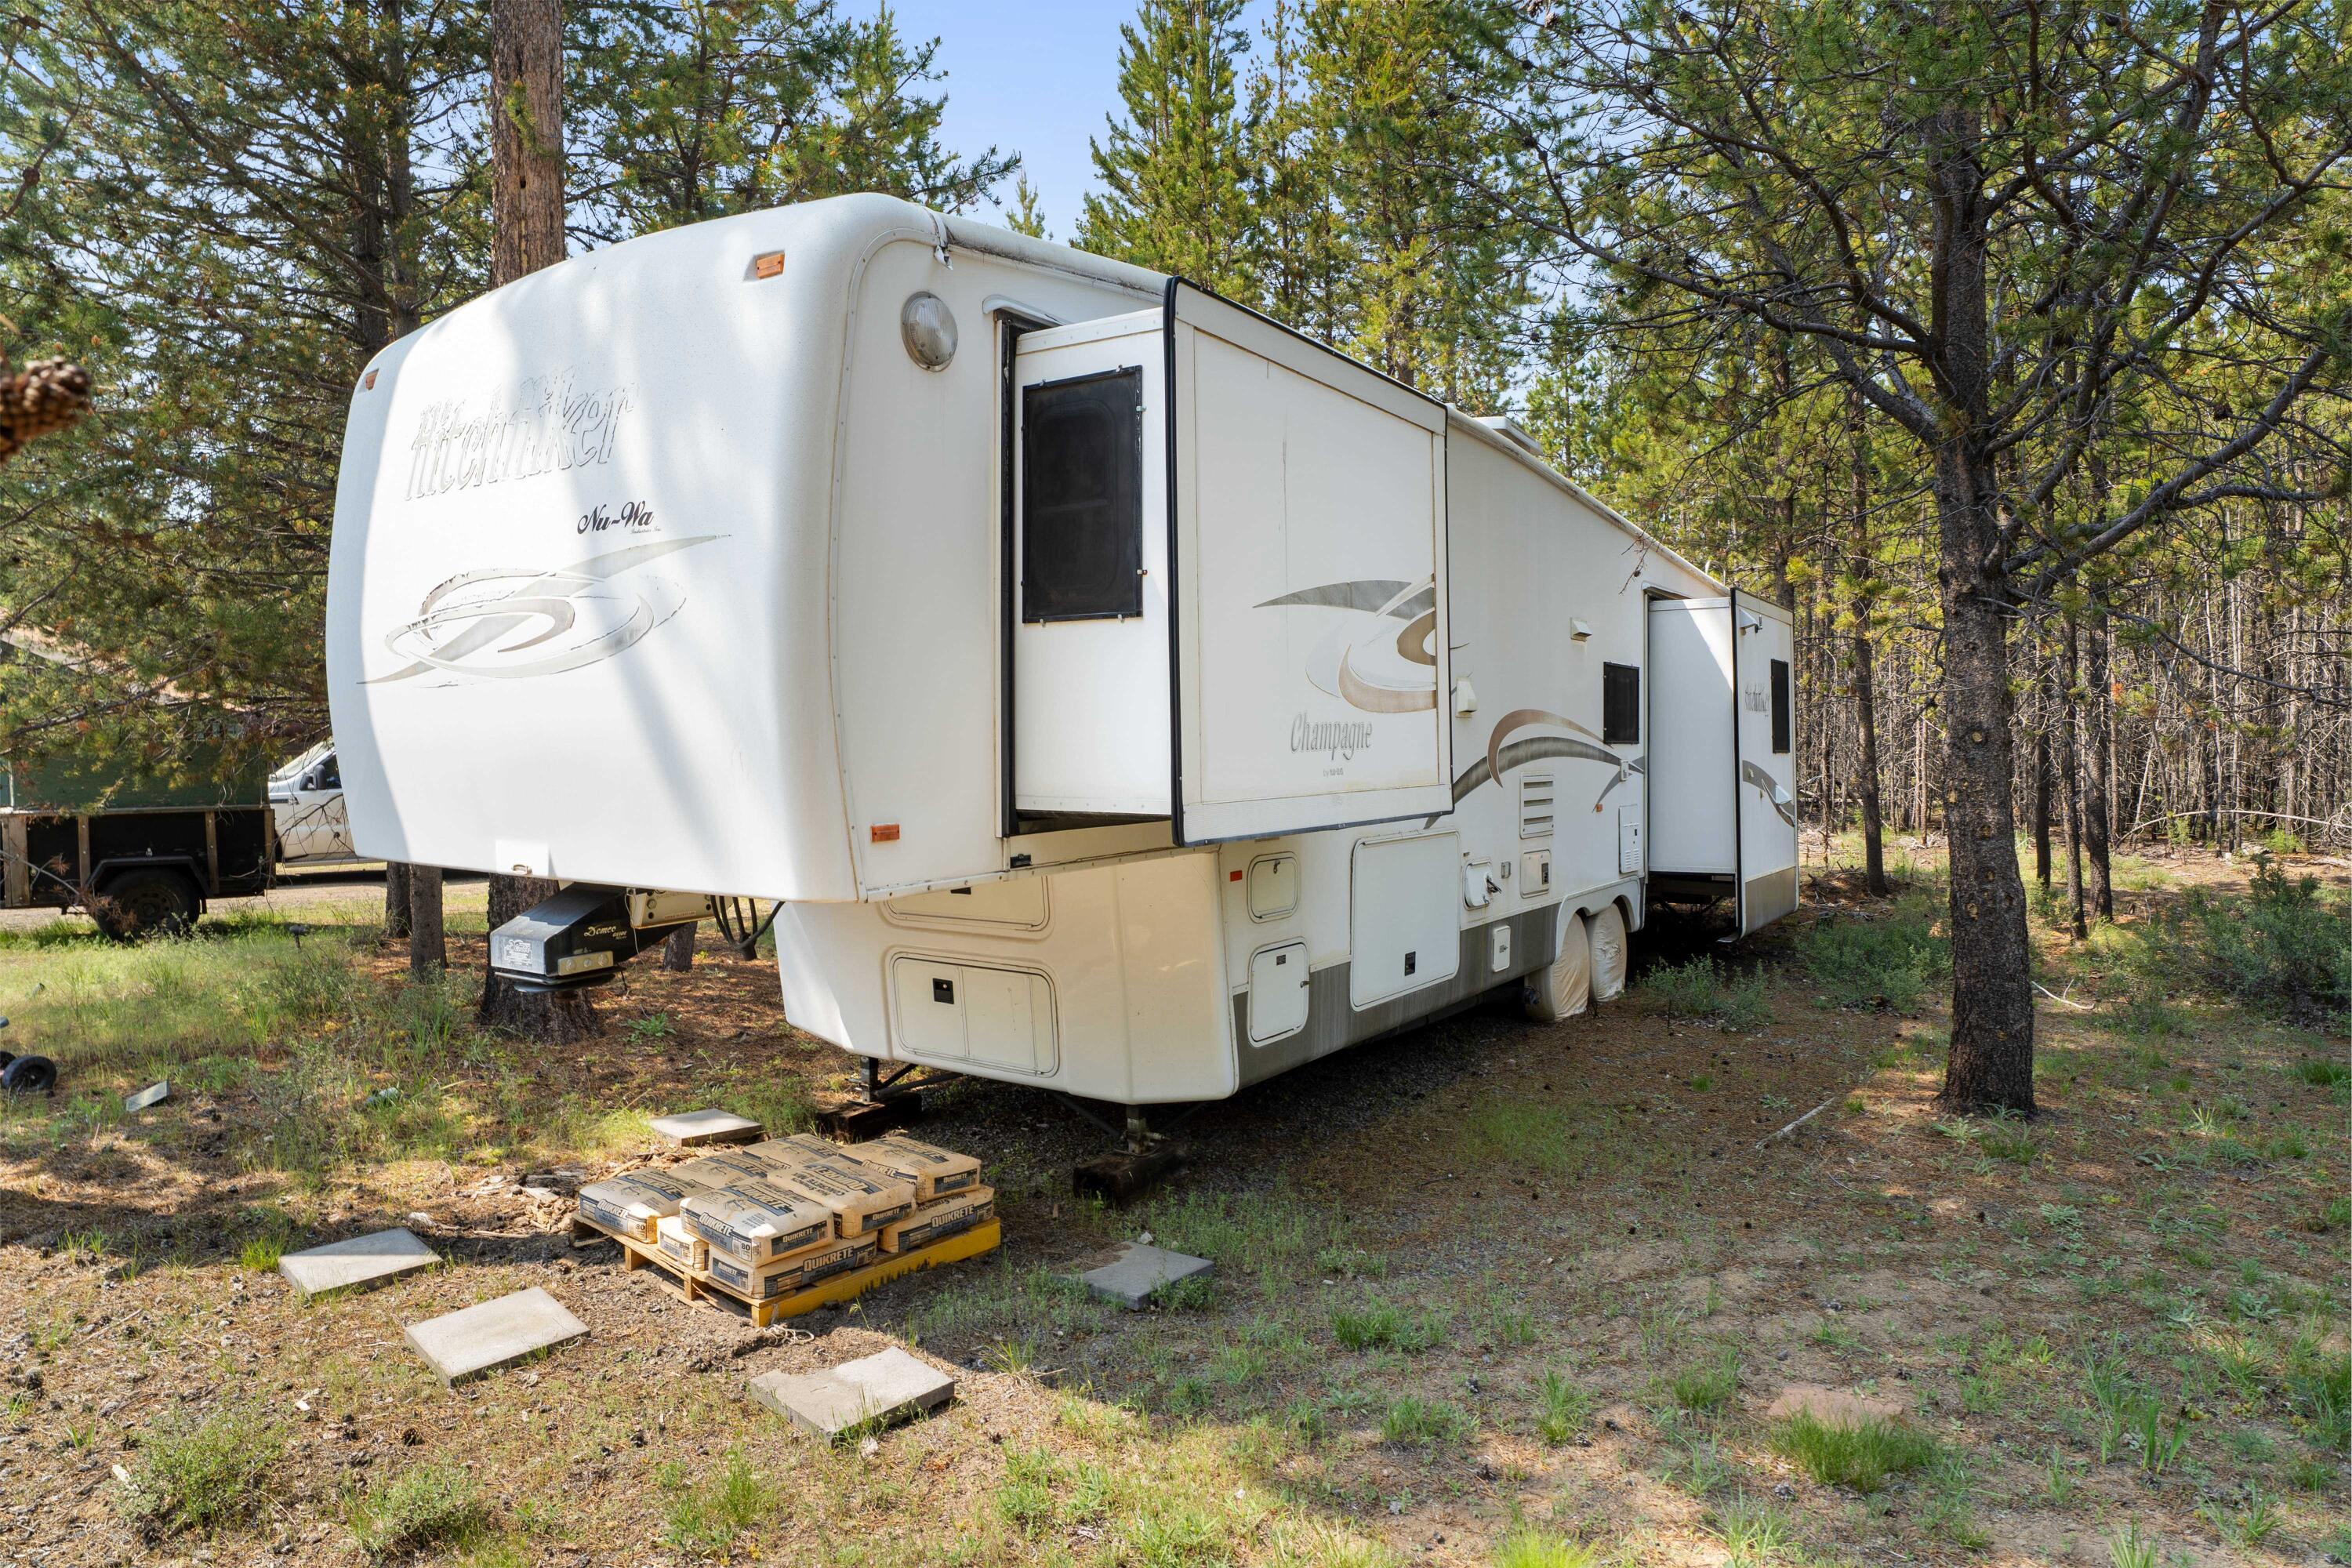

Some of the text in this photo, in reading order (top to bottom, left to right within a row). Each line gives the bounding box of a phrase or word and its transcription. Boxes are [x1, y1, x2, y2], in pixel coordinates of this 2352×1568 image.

[577, 500, 654, 535] Nu-Wa
[1290, 710, 1373, 760] Champagne
[862, 1160, 896, 1177] QUIKRETE
[597, 1200, 630, 1219] QUIKRETE
[931, 1205, 975, 1229] QUIKRETE
[699, 1213, 734, 1237] QUIKRETE
[782, 1227, 814, 1243] QUIKRETE
[741, 1243, 750, 1251] 80
[804, 1247, 854, 1272] QUIKRETE
